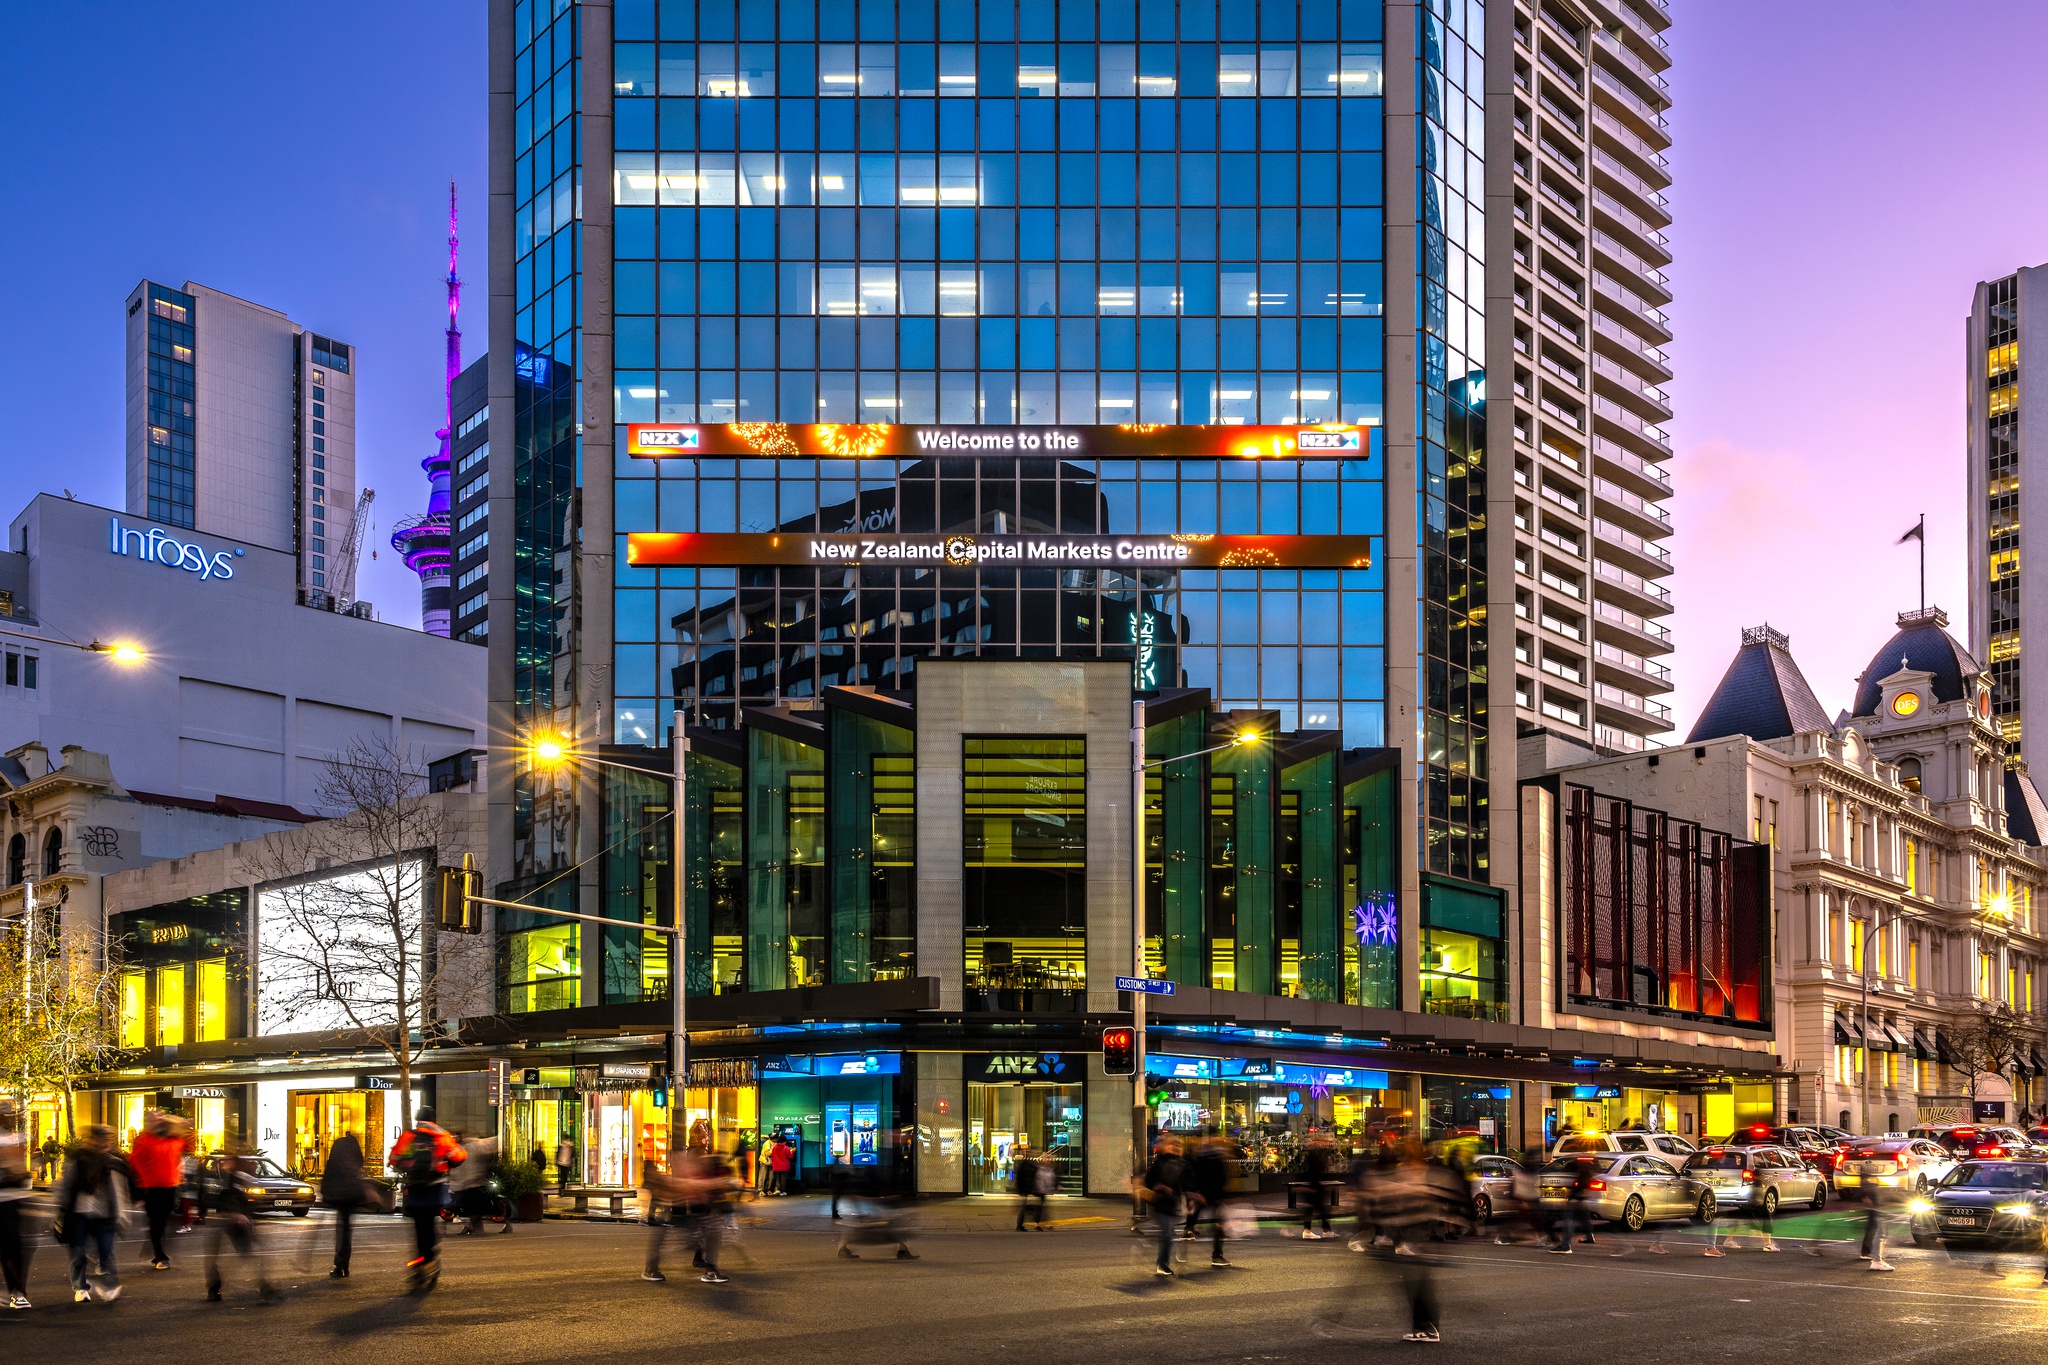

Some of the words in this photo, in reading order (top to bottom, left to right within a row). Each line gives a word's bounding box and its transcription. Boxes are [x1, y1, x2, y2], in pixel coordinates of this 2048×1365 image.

[641, 432, 680, 445] NZX
[917, 431, 1014, 449] Welcome
[1018, 433, 1040, 449] to
[1044, 431, 1079, 449] the
[1301, 434, 1341, 447] NZX
[810, 541, 857, 558] New
[861, 541, 945, 558] Zealand
[950, 541, 1022, 562] Capital
[1027, 541, 1113, 559] Markets
[1116, 541, 1188, 559] Centre
[1897, 698, 1919, 710] DFS
[152, 925, 189, 943] PRADA
[1118, 978, 1146, 990] CUSTOMS
[615, 1067, 646, 1075] SWAROVSKI
[766, 1062, 780, 1070] ANZ
[985, 1056, 1037, 1074] ANZ
[1245, 1065, 1261, 1074] ANZ
[369, 1078, 393, 1089] Dior
[183, 1088, 227, 1098] PRADA
[264, 1127, 280, 1141] Dior
[1948, 1216, 1974, 1225] NMG691
